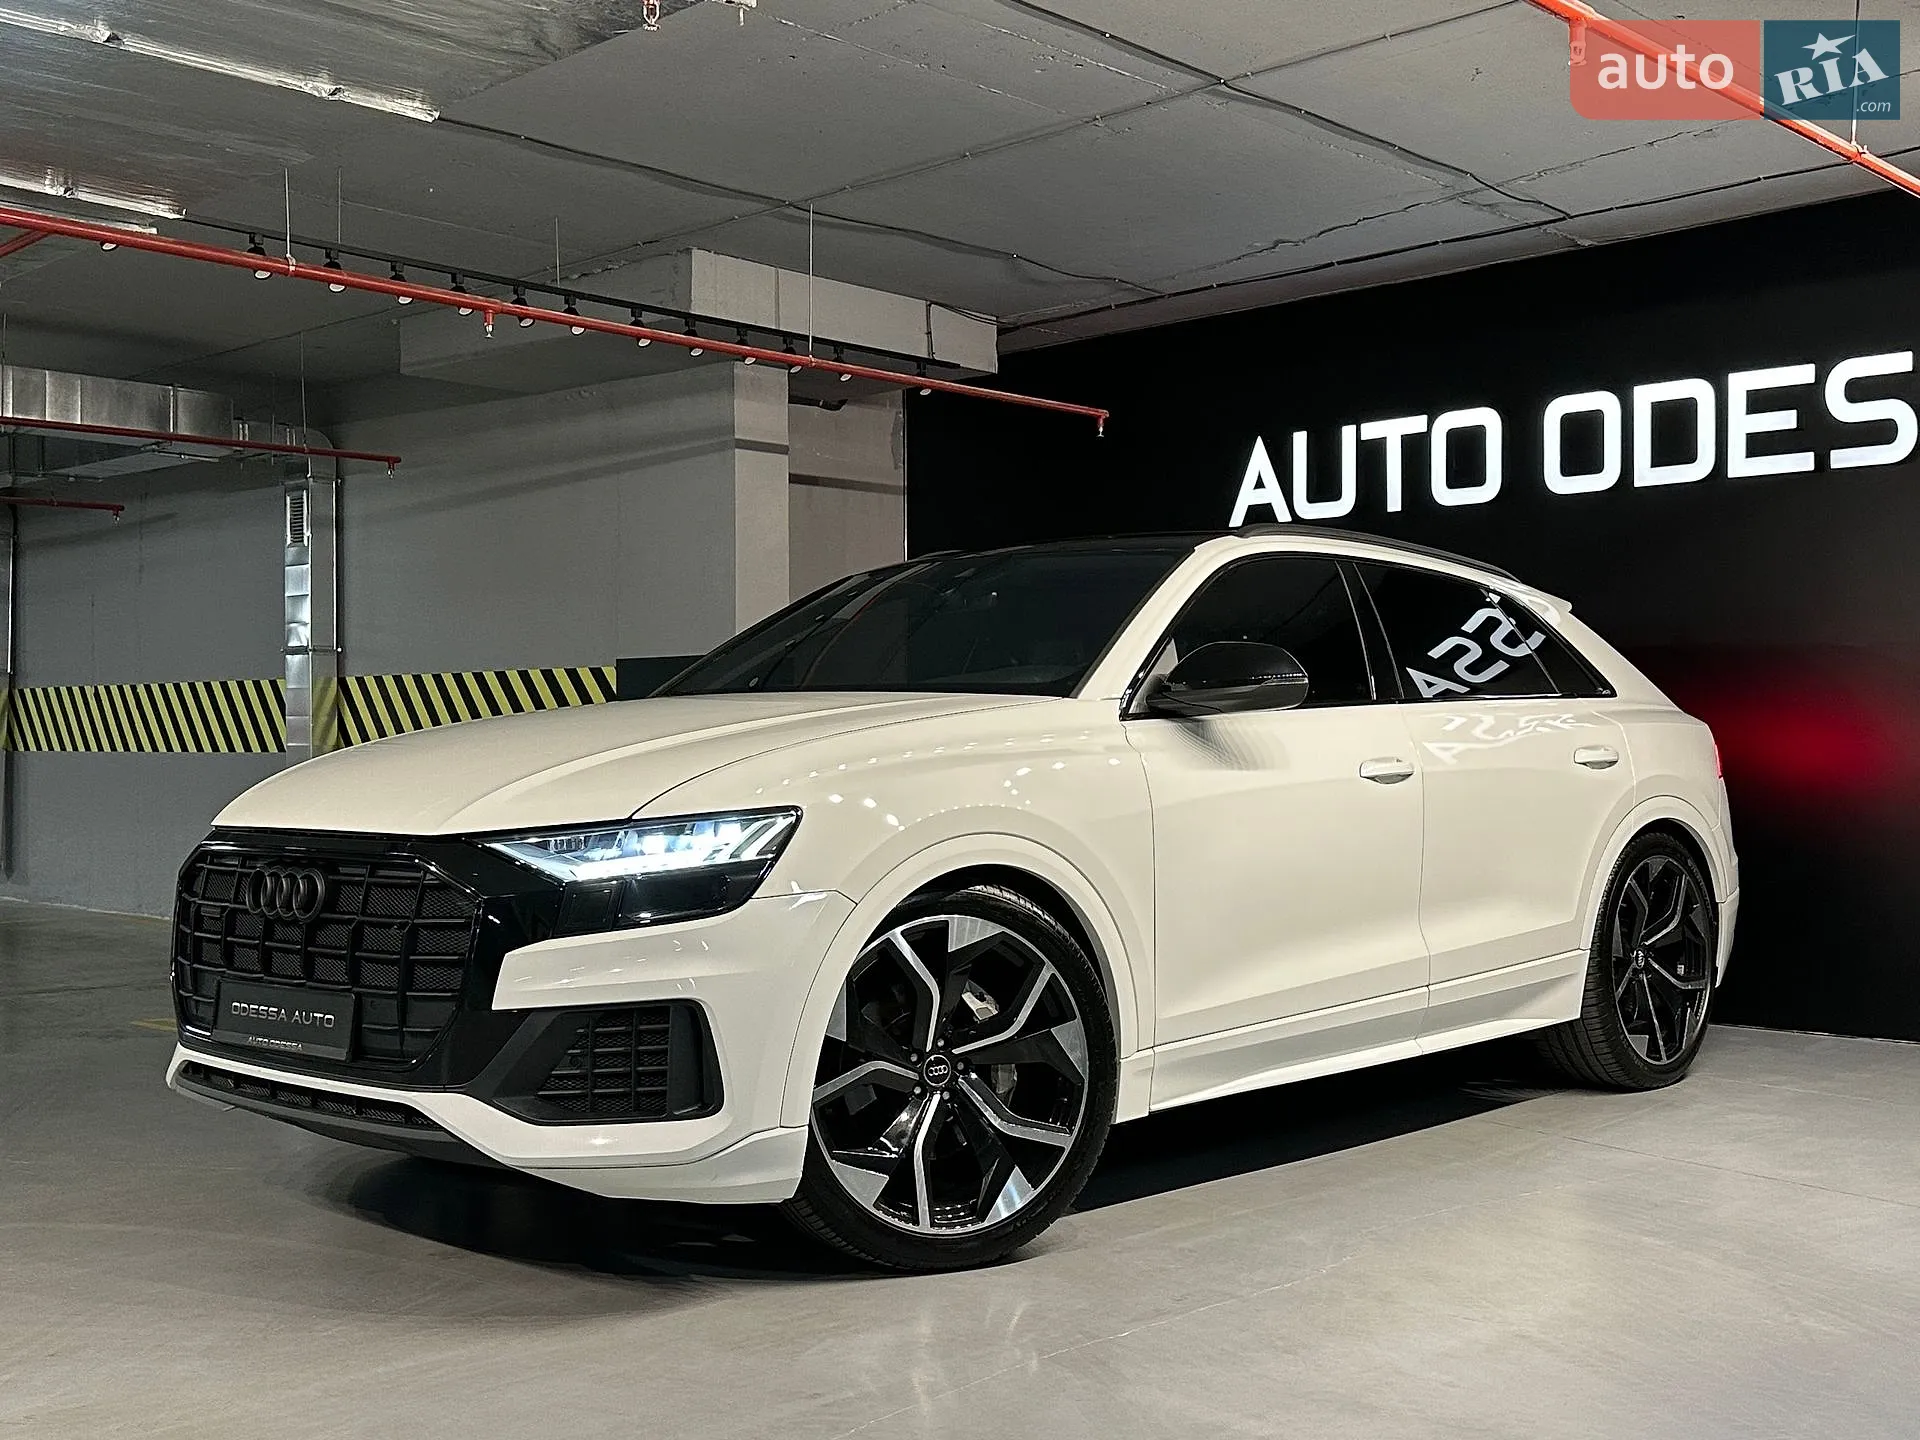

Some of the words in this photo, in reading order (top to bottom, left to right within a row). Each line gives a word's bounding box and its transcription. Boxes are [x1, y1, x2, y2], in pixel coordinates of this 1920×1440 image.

[1229, 407, 1502, 527] AUTO
[1543, 351, 1918, 495] ODES
[231, 1001, 287, 1022] ODESSA
[291, 1009, 335, 1028] AUTO
